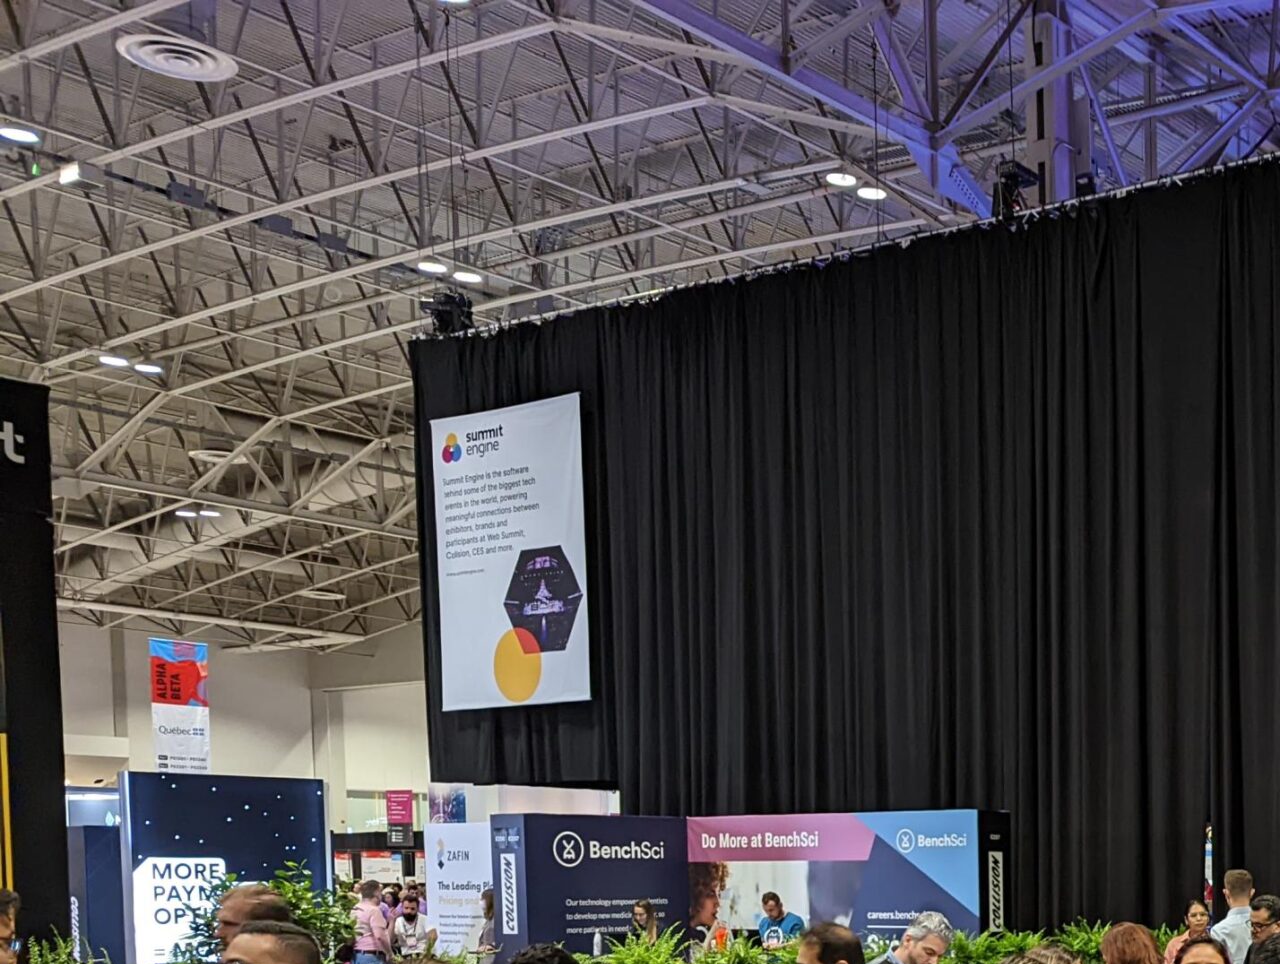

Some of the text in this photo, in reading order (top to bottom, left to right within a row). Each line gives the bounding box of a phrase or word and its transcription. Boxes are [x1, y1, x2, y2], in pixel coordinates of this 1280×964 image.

[466, 424, 503, 442] summit
[466, 440, 499, 457] engine
[442, 466, 528, 486] Summit Engine is the software
[463, 486, 480, 494] some
[480, 483, 486, 492] of
[487, 482, 497, 491] the
[499, 479, 520, 490] biggest
[522, 477, 536, 486] tech
[464, 500, 469, 508] in
[470, 498, 480, 506] the
[480, 495, 498, 504] world,
[499, 492, 528, 502] powering
[476, 506, 512, 518] connections
[513, 502, 540, 512] between
[475, 521, 495, 530] brands
[496, 519, 508, 528] and
[487, 533, 500, 542] Web
[501, 529, 525, 540] Summit,
[471, 546, 484, 556] CES
[485, 545, 496, 554] and
[156, 663, 167, 699] ALPHA
[170, 673, 181, 700] BETA
[158, 725, 192, 736] Québec
[701, 831, 819, 848] Do More at BenchSci
[917, 833, 968, 848] BenchSci
[447, 850, 470, 862] ZAFIN
[589, 841, 664, 859] BenchSci
[152, 862, 220, 880] MORE
[437, 881, 450, 890] The
[452, 881, 481, 892] Leading
[502, 856, 515, 932] COLLISION
[991, 854, 1001, 929] COLLISION
[565, 898, 579, 906] Our
[579, 898, 611, 907] technology
[565, 912, 573, 920] to
[573, 911, 598, 920] develop
[598, 912, 610, 920] new
[566, 926, 582, 934] more
